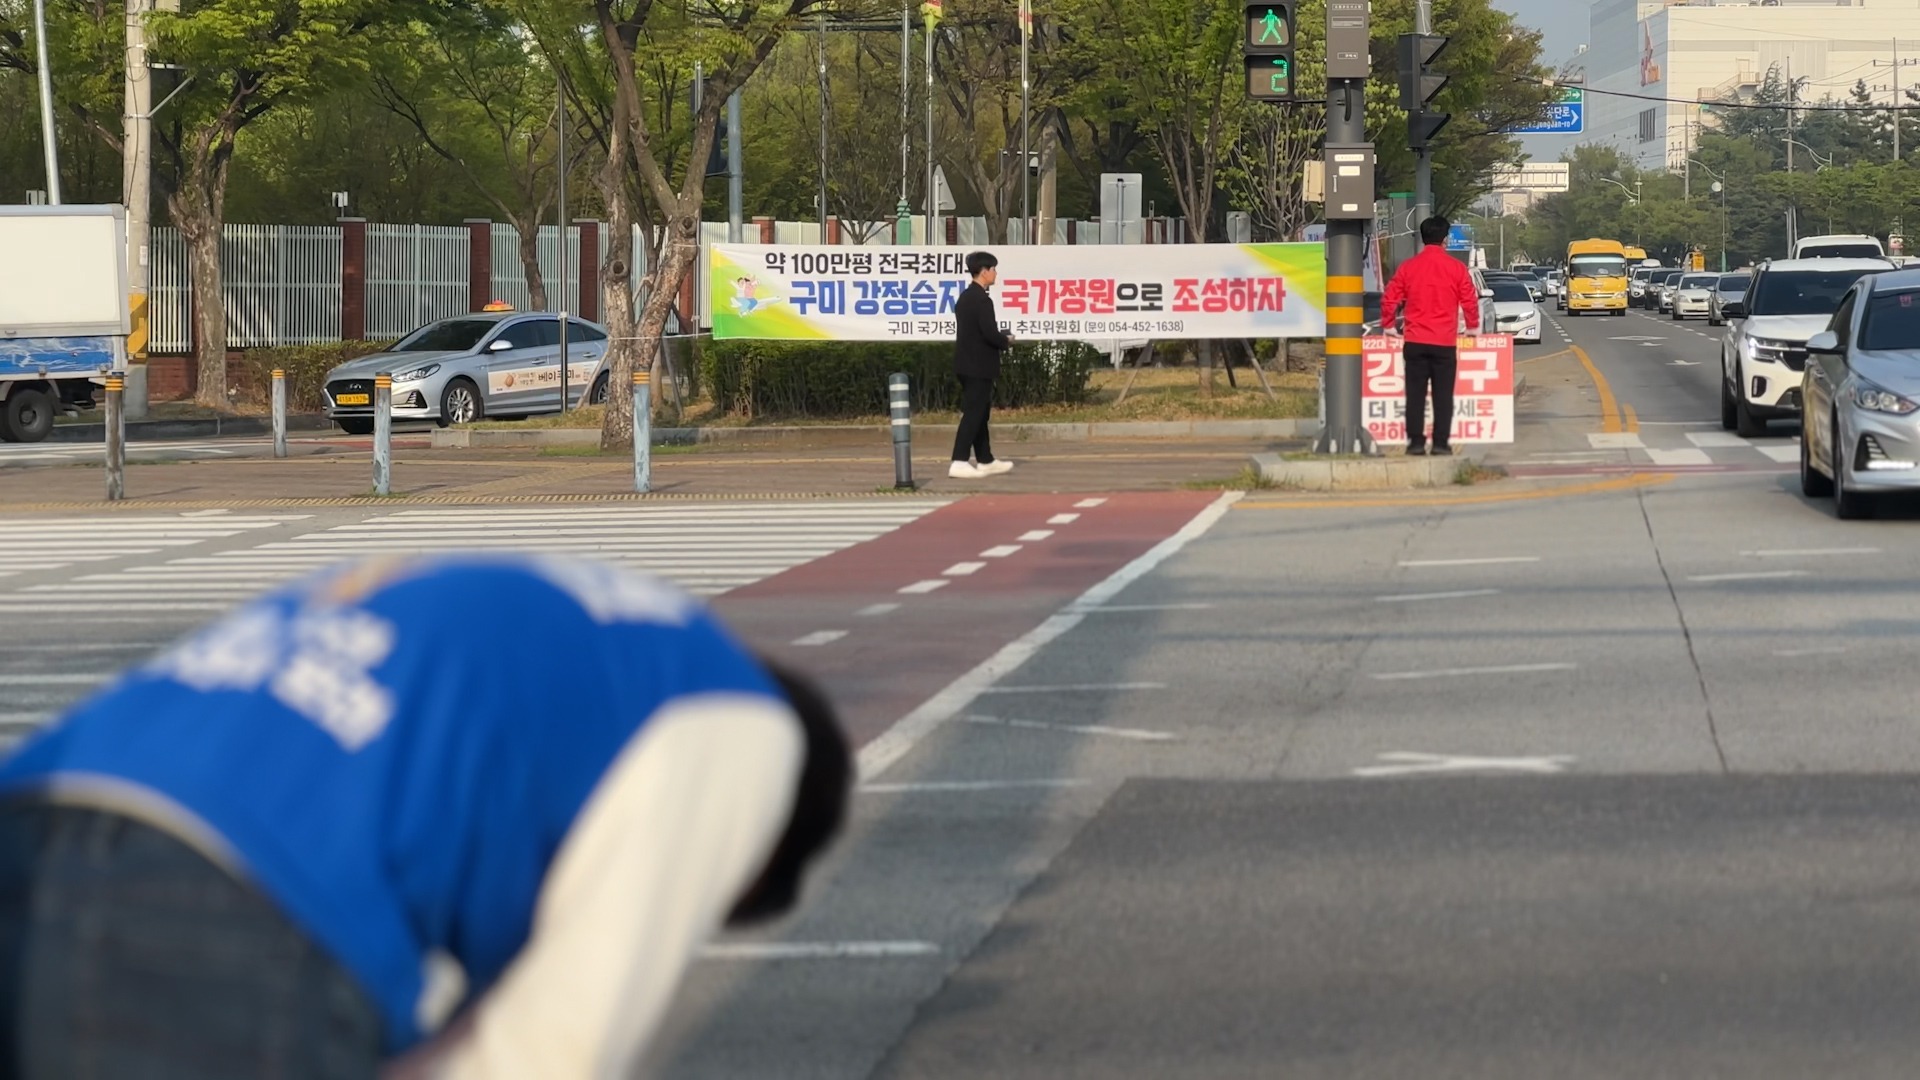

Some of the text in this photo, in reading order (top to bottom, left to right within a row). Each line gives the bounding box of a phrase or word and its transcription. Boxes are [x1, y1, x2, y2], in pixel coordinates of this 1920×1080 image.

[1272, 60, 1287, 92] 2
[765, 252, 970, 275] 약 100만평 전국최대
[790, 280, 846, 315] 구미
[1001, 278, 1164, 315] 국가정원으로
[1172, 277, 1286, 313] 조성하자
[888, 321, 913, 335] 구미
[1016, 320, 1080, 335] 추진위원회
[1084, 320, 1106, 334] (문의
[1108, 320, 1184, 333] 054-452-1638)
[1362, 336, 1386, 350] 22대
[1368, 401, 1386, 418] 더
